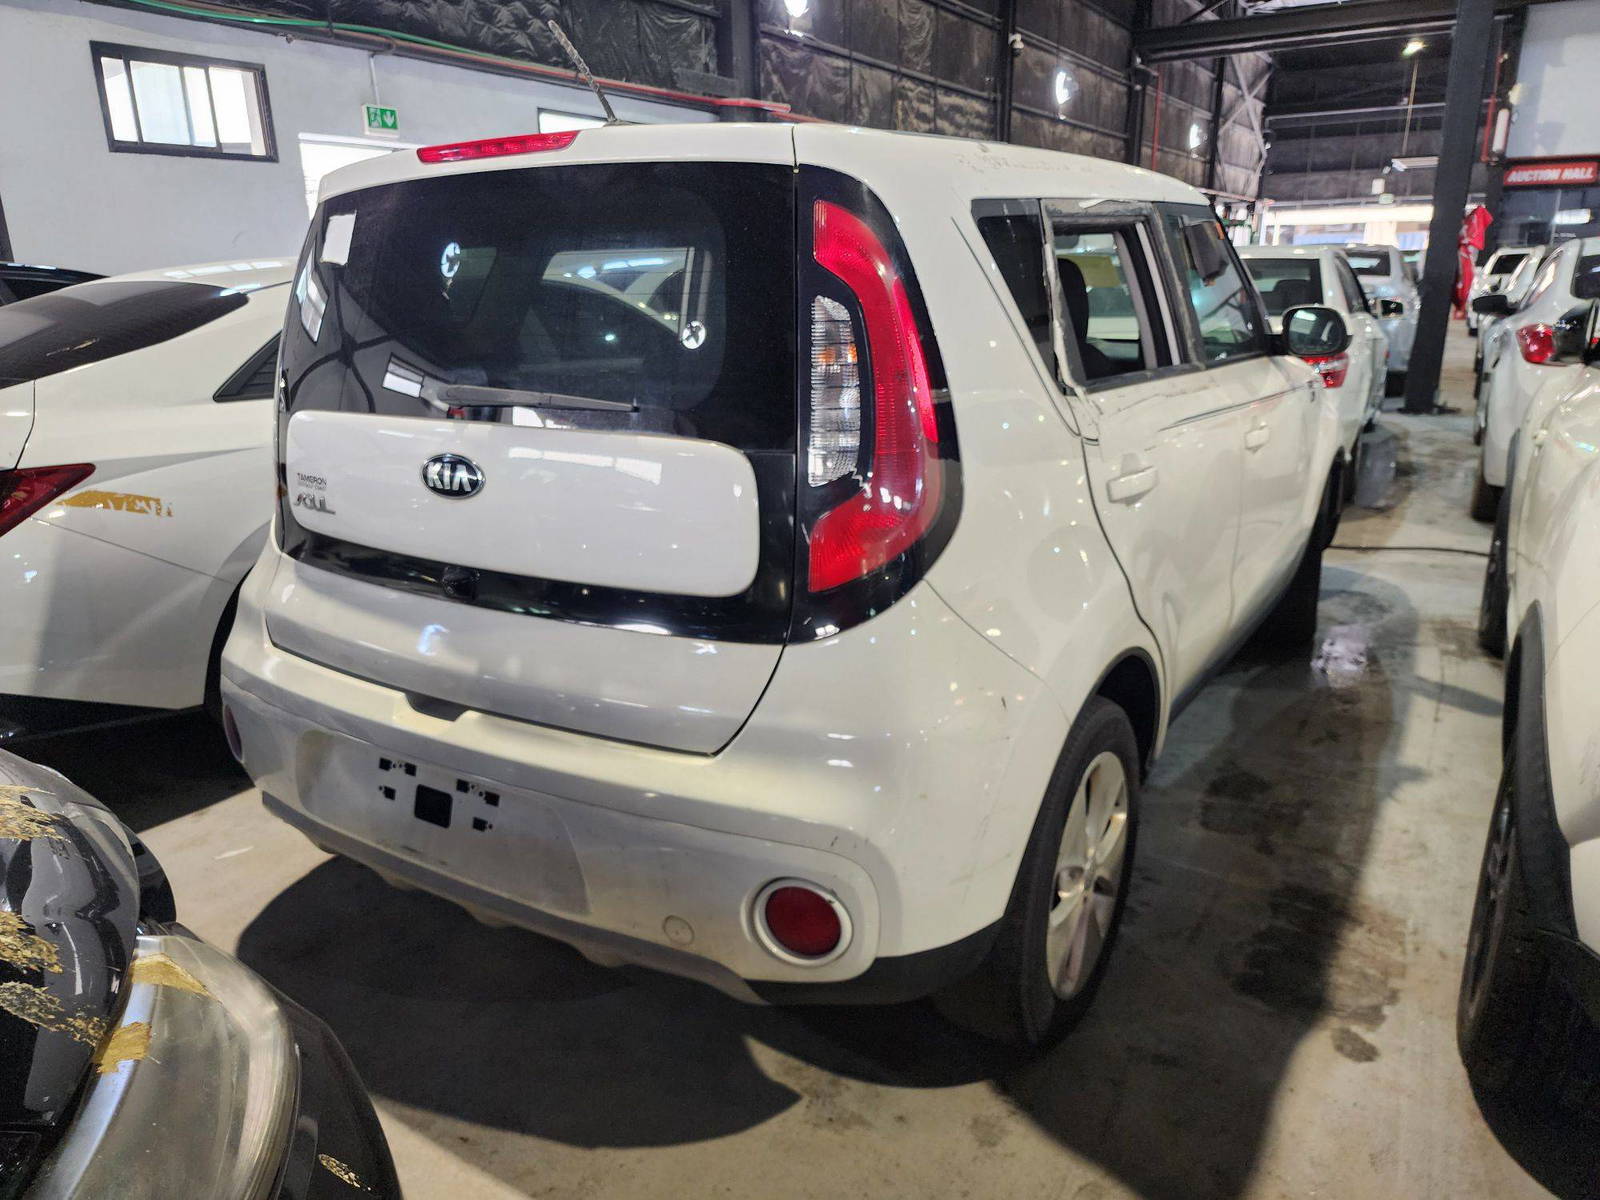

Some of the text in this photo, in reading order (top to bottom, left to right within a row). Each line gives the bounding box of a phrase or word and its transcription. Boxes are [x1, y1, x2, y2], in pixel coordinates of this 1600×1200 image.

[1507, 167, 1594, 182] AUCTION HALL
[426, 461, 473, 492] KIA
